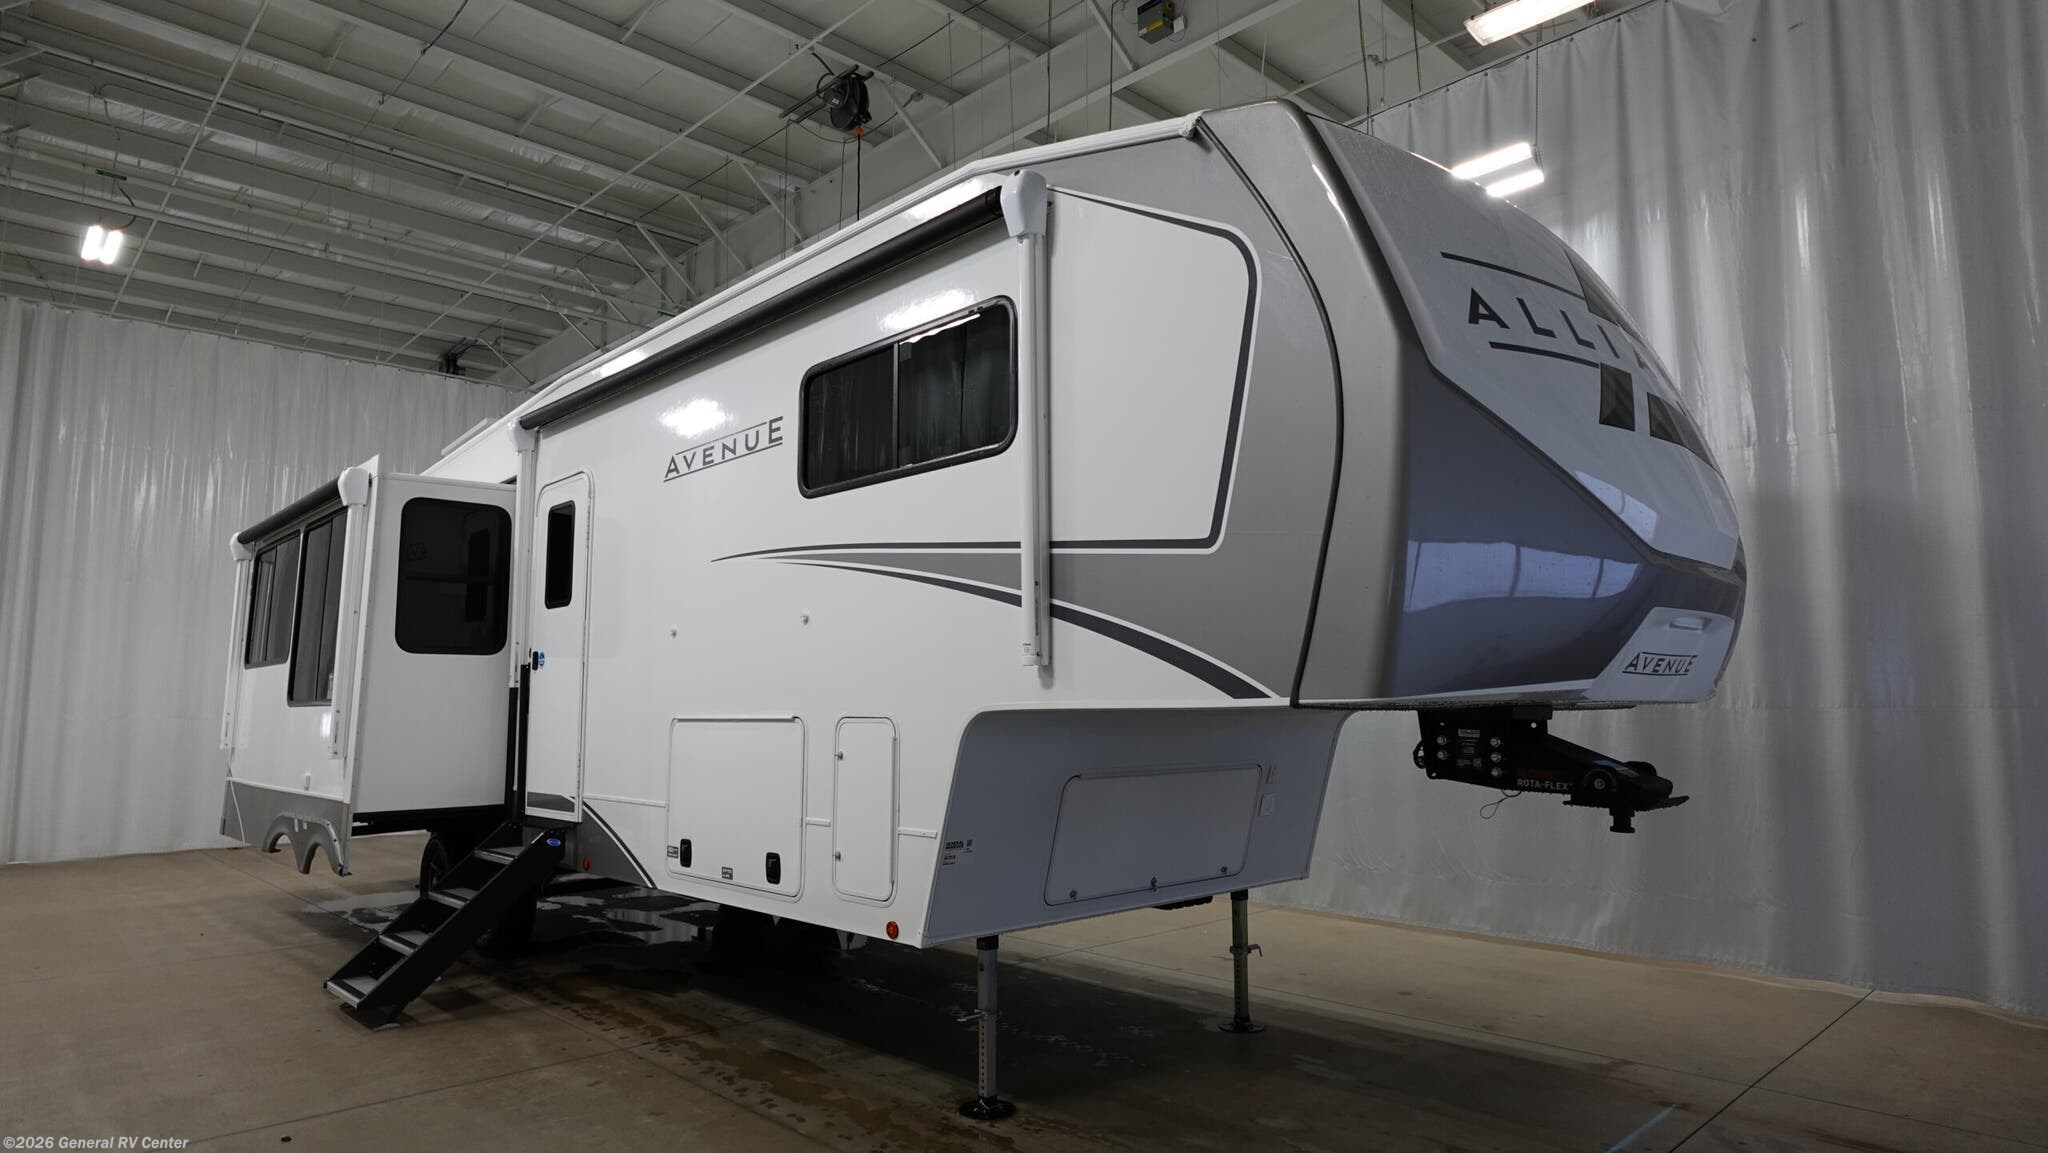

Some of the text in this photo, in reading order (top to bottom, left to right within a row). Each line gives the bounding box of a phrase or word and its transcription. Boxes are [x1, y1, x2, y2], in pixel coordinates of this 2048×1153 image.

[664, 416, 783, 479] AVENUE
[1624, 651, 1698, 674] AVENUE
[1516, 778, 1568, 791] ROTA-FLEX
